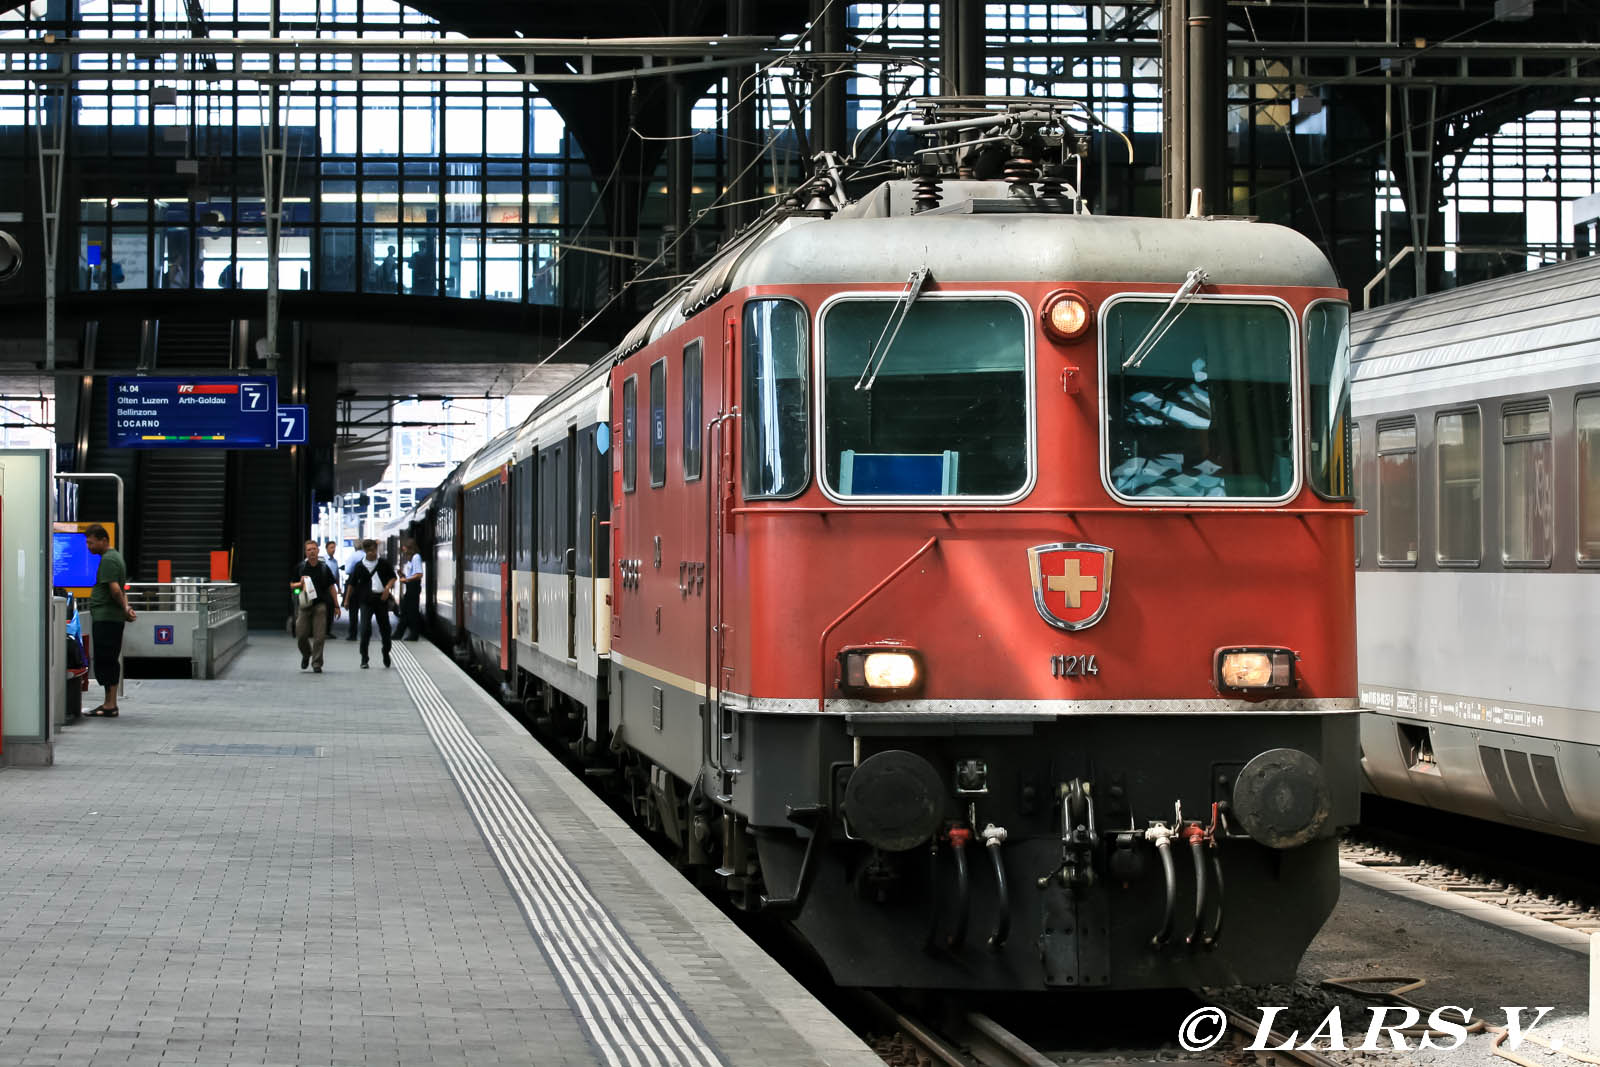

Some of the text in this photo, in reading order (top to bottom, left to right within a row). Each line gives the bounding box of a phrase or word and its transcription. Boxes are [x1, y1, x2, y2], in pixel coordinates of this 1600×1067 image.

[117, 397, 226, 405] Olten Luzern Arth-Goldau
[248, 392, 261, 409] 7
[117, 408, 157, 416] Bellinzona
[117, 420, 160, 428] LOCARNO
[280, 417, 296, 438] 7
[1050, 654, 1099, 676] 11214
